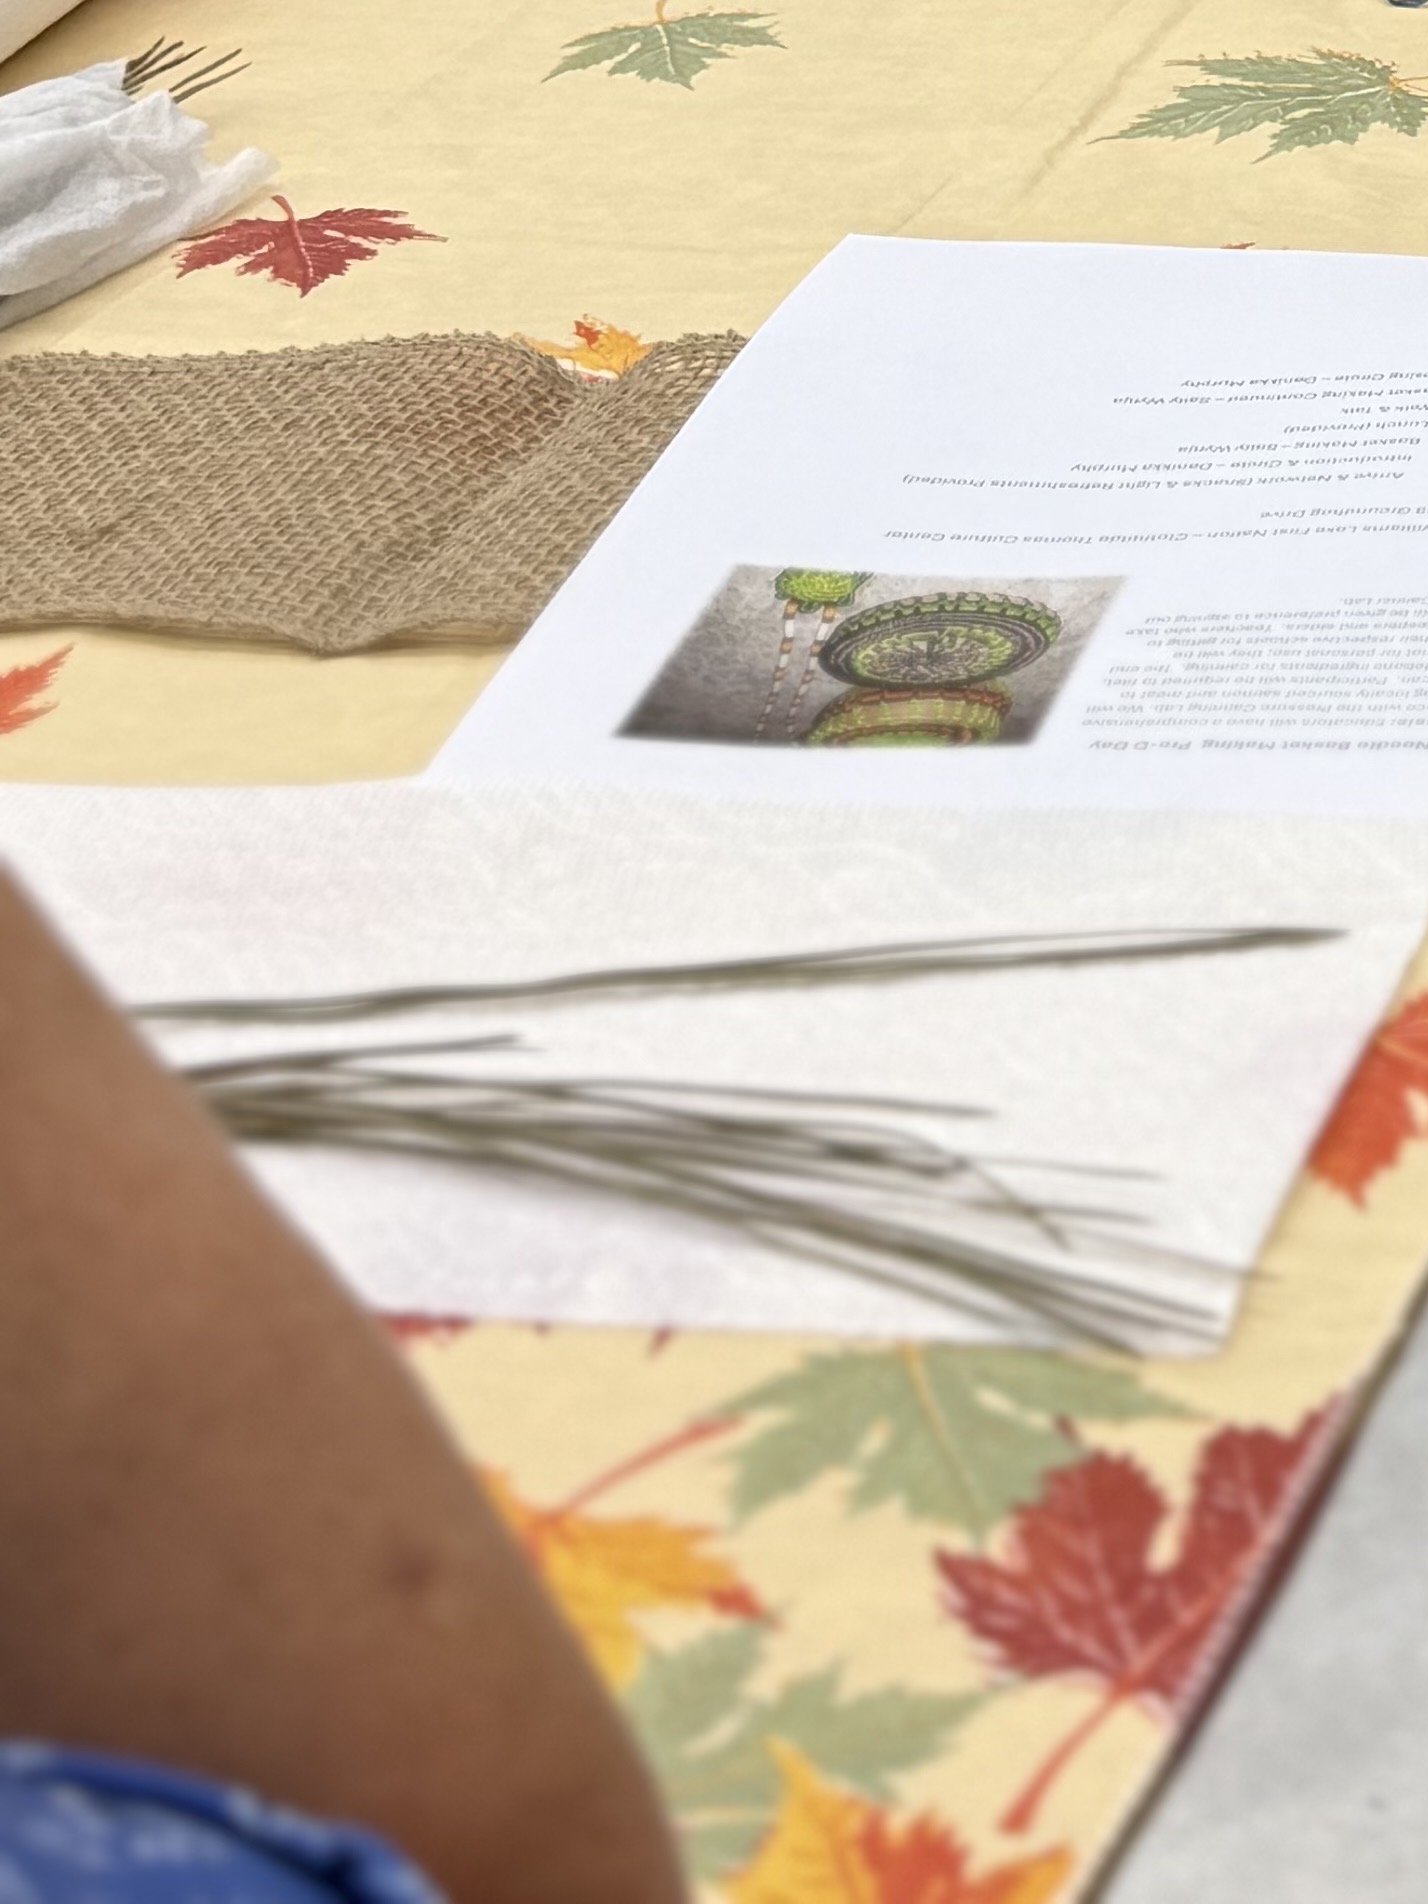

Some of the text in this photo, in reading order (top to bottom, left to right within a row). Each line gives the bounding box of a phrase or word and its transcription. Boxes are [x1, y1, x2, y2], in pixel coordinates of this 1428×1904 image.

[1180, 380, 1244, 389] Murphy
[1227, 392, 1317, 402] Continued
[1321, 390, 1384, 399] Making
[1283, 422, 1371, 434] (Provided)
[1376, 420, 1428, 429] Lunch
[1294, 440, 1357, 449] Making
[1361, 437, 1420, 447] Basket
[1070, 463, 1138, 473] Murphy
[1256, 474, 1332, 483] Network
[1354, 472, 1405, 480] Arrive
[902, 475, 985, 487] Provided)
[990, 480, 1114, 490] Refreshments
[1118, 480, 1161, 490] Light
[1183, 477, 1253, 490] (Snacks
[1260, 510, 1306, 518] Drive
[1310, 507, 1411, 516] Groundhog
[1272, 527, 1310, 536] First
[1315, 525, 1357, 533] Lake
[882, 530, 946, 542] Center
[1207, 529, 1267, 539] Nation
[949, 534, 1018, 544] Culture
[1023, 536, 1093, 544] Thomas
[1143, 678, 1157, 686] to
[1234, 677, 1254, 685] be
[1259, 676, 1285, 685] will
[1291, 675, 1388, 686] Participants
[1120, 691, 1135, 699] to
[1185, 691, 1217, 699] and
[1222, 690, 1281, 698] salmon
[1285, 690, 1351, 699] sourced
[1356, 689, 1409, 699] locally
[1086, 705, 1113, 713] will
[1118, 705, 1143, 713] We
[1260, 704, 1331, 712] Pressure
[1337, 704, 1362, 712] the
[1368, 704, 1401, 712] with
[1082, 717, 1208, 727] comprehensive
[1227, 719, 1265, 727] have
[1268, 719, 1297, 727] will
[1303, 719, 1385, 727] Educators
[1088, 741, 1129, 750] Day
[1134, 741, 1192, 750] Pro-D
[1201, 740, 1275, 750] Making
[1282, 741, 1350, 750] Basket
